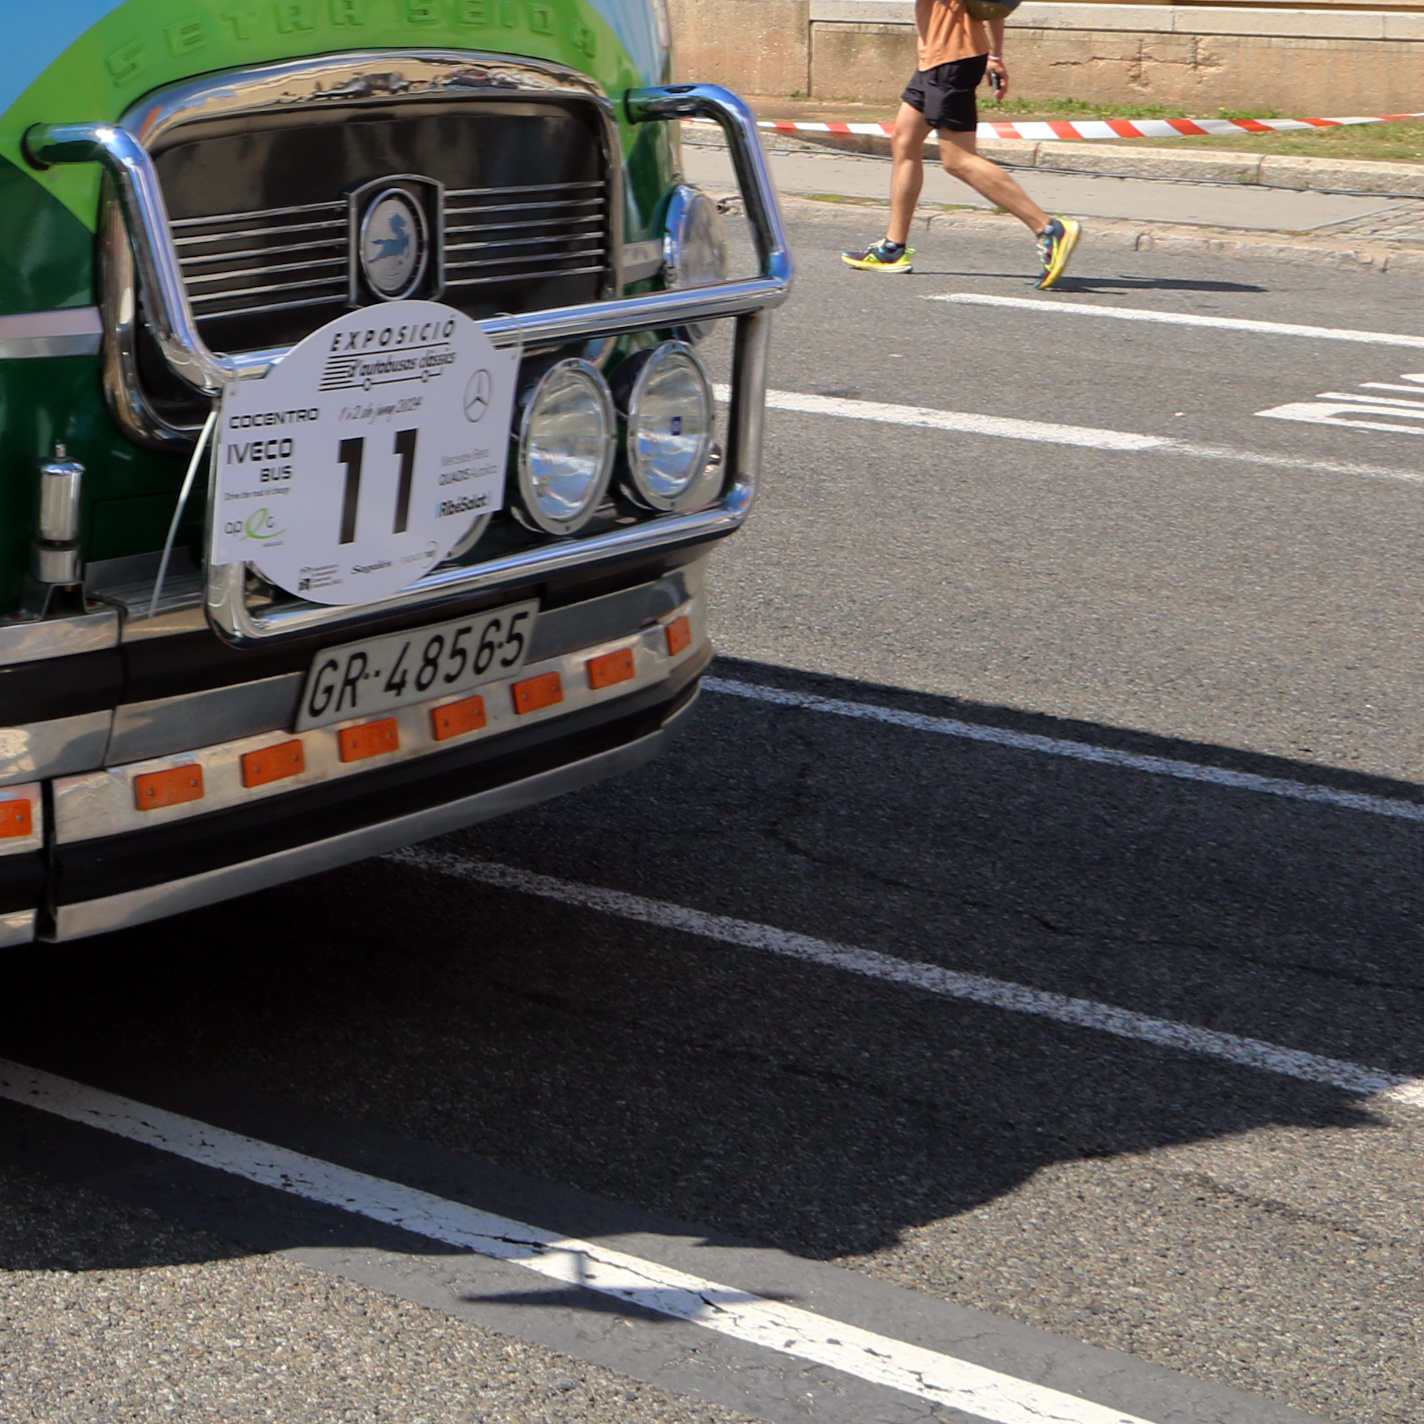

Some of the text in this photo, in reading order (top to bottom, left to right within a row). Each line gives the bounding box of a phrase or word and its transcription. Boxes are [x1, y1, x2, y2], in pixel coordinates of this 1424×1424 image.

[229, 408, 319, 429] COCENTRO
[227, 438, 293, 465] IVECO
[260, 465, 292, 482] BUS
[337, 428, 417, 545] 11
